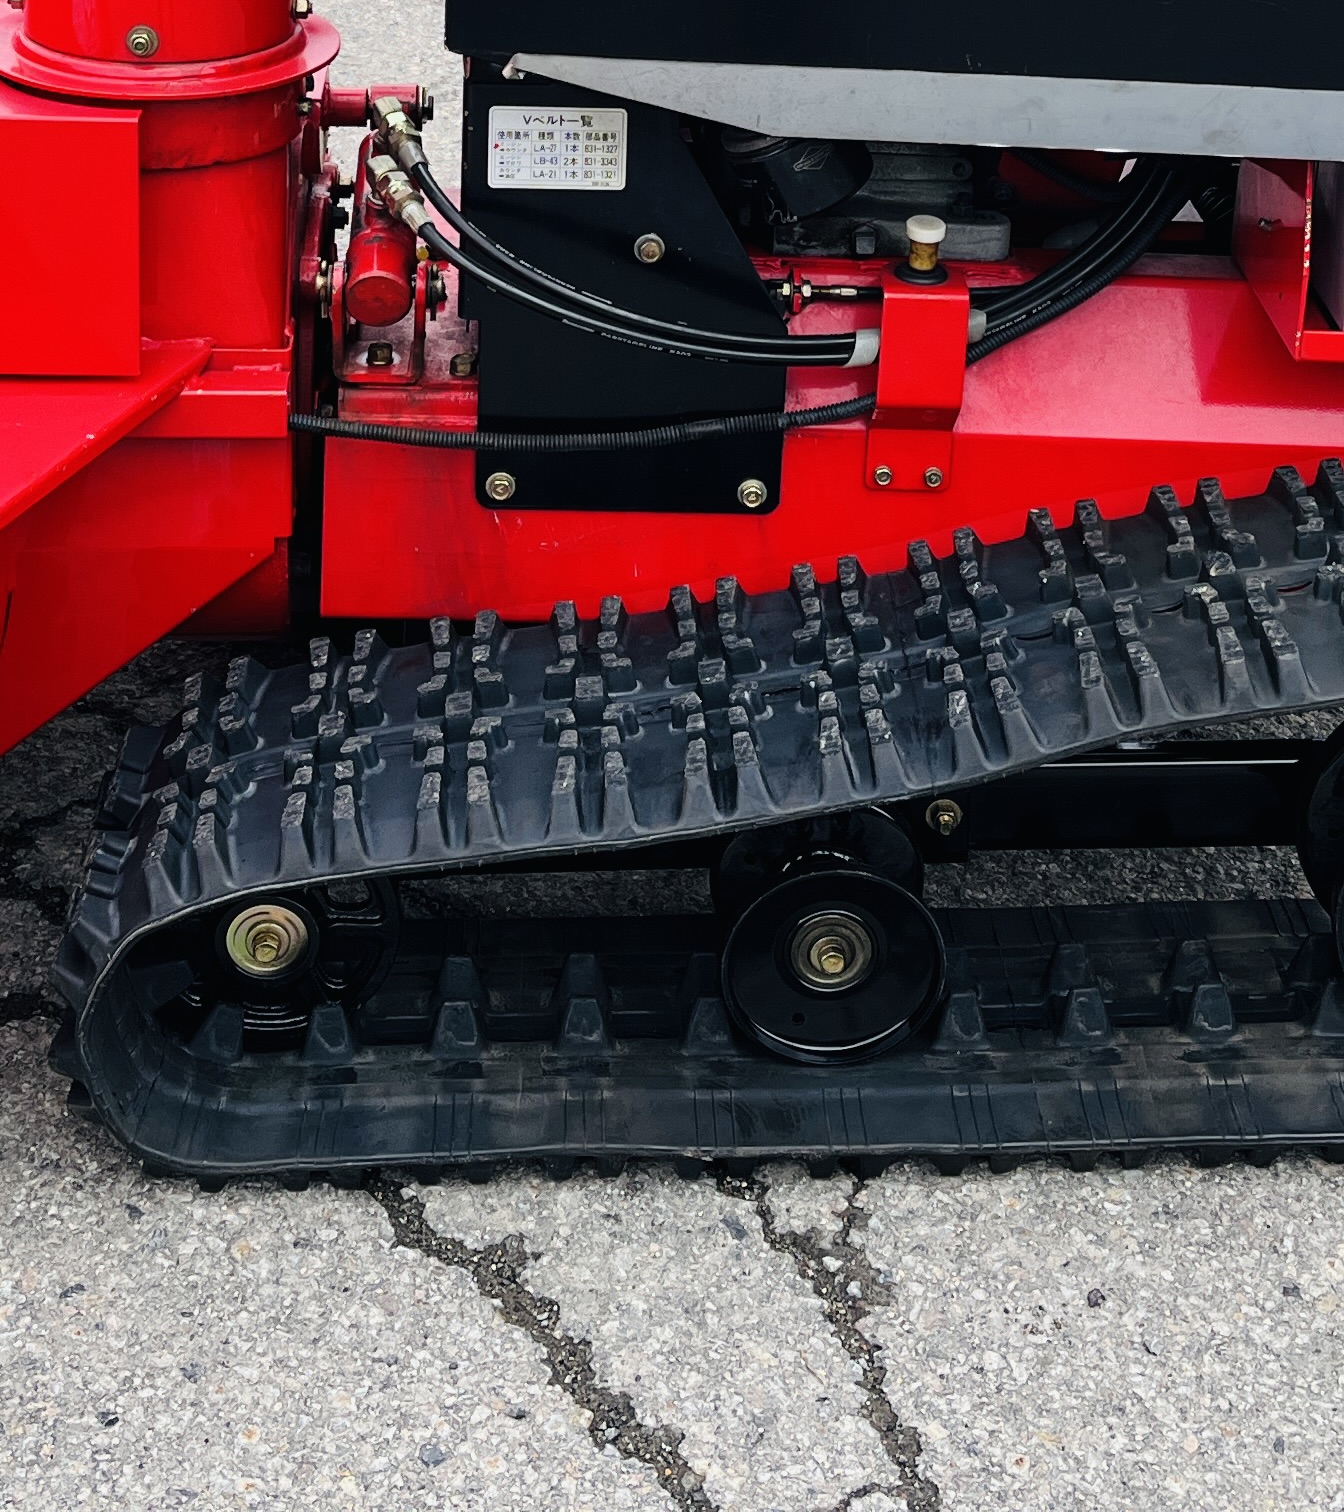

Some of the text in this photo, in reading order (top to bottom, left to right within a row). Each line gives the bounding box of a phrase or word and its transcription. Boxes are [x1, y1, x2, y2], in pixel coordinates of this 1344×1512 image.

[522, 114, 594, 128] Vベルト一覧
[563, 156, 579, 166] 2本
